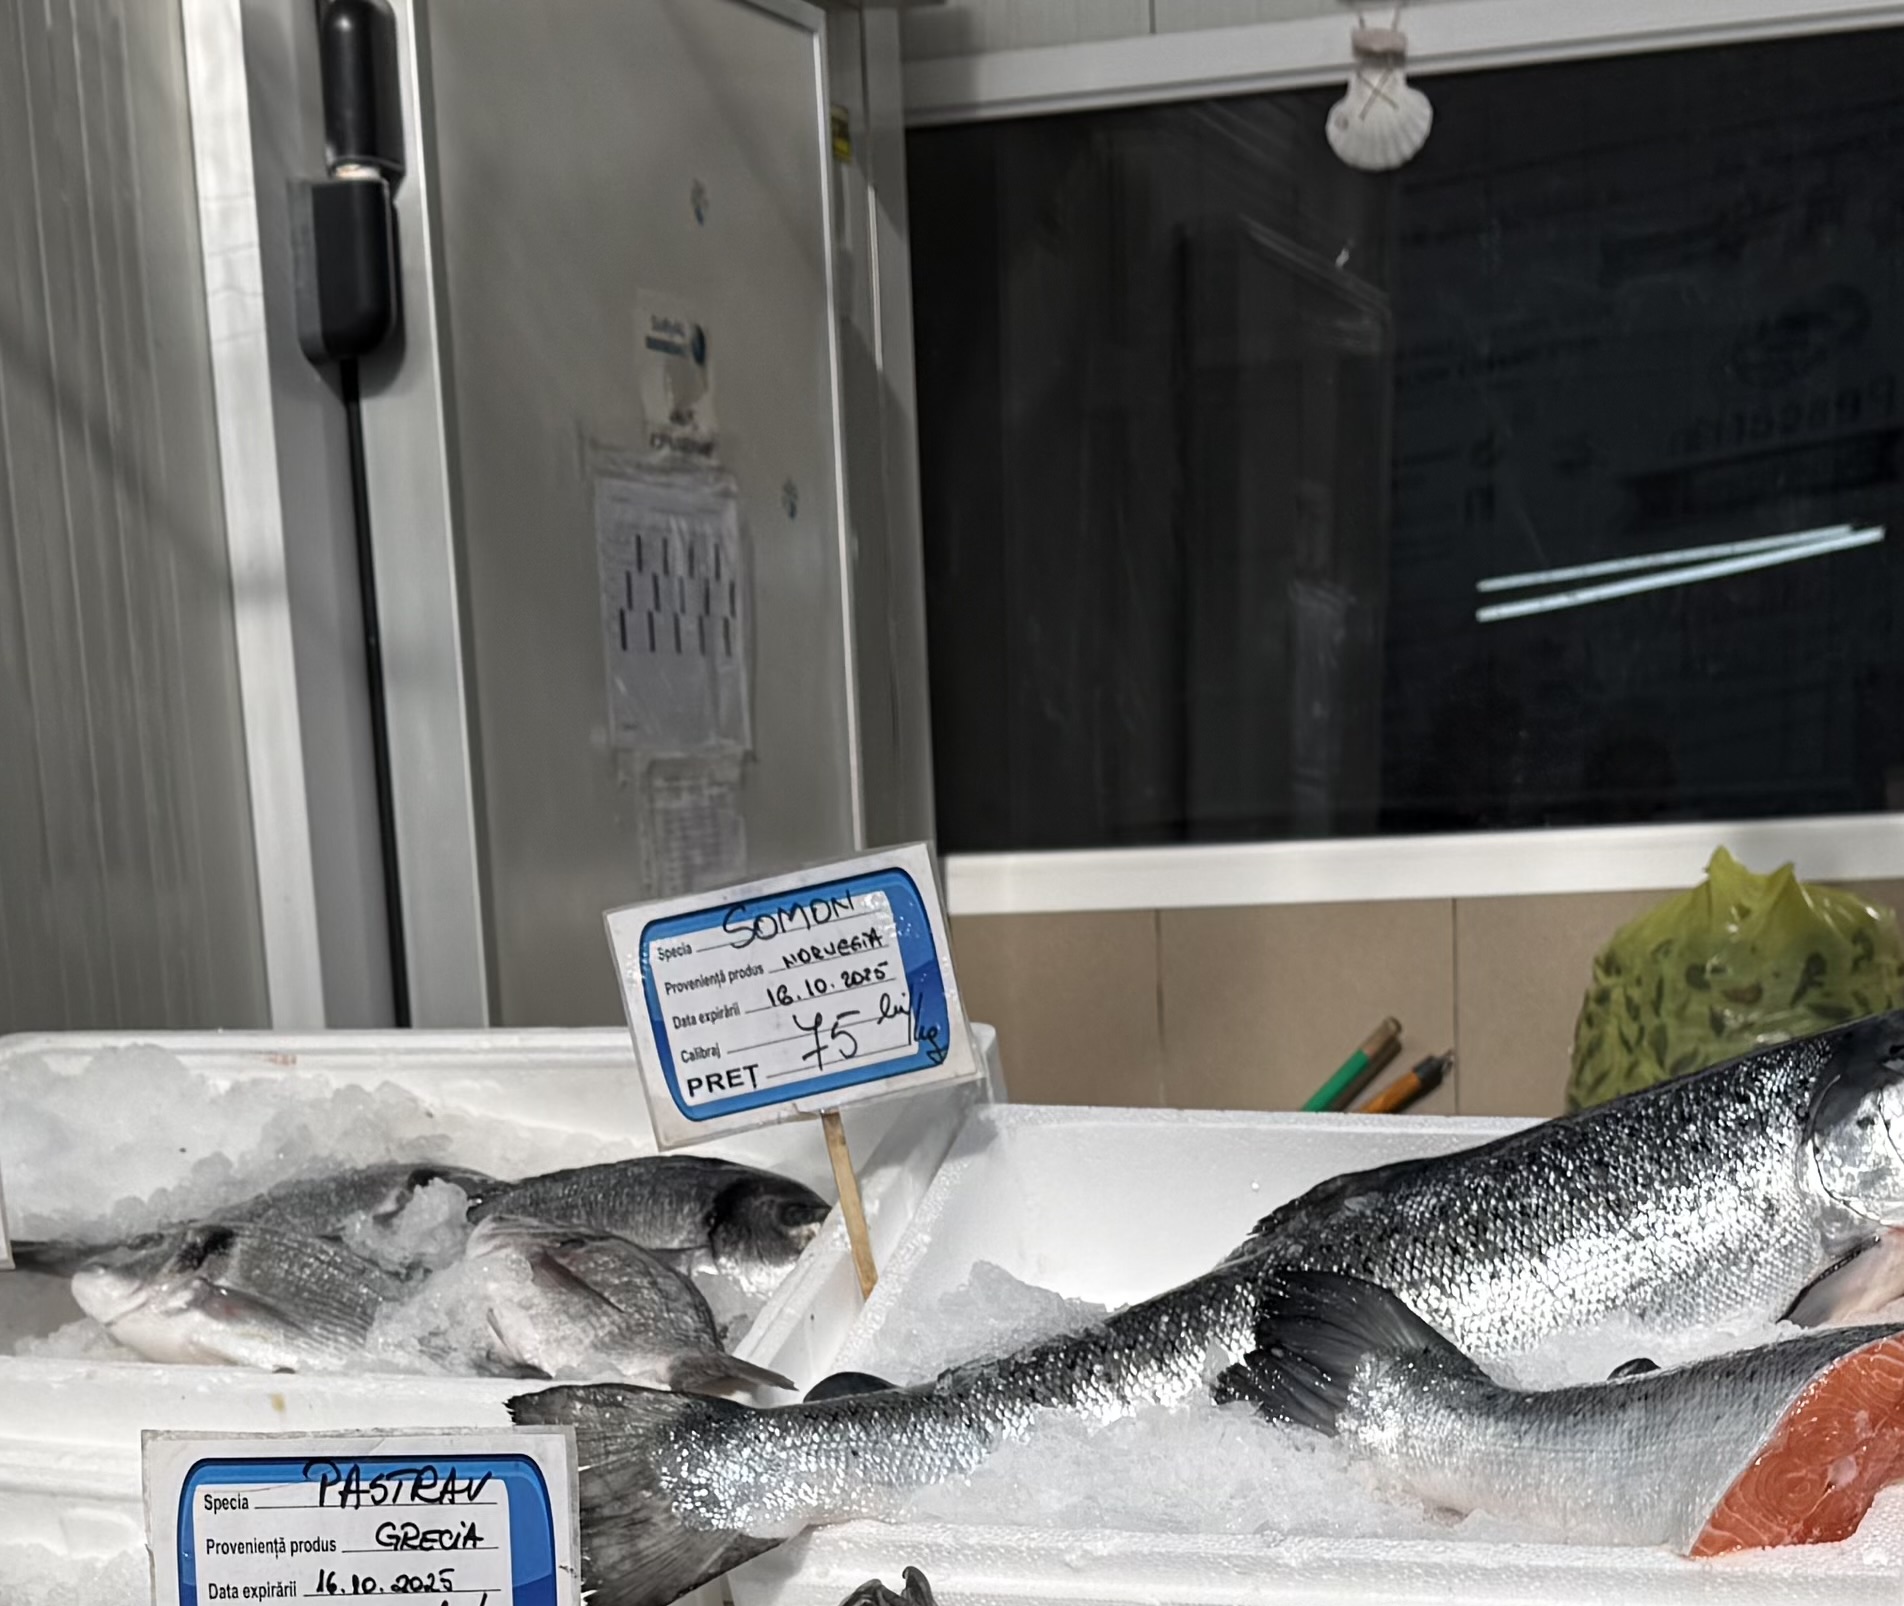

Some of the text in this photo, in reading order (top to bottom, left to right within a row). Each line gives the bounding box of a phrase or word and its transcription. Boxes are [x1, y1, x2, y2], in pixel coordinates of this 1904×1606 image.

[657, 888, 856, 961] Specia SOMON
[664, 970, 727, 996] Proveniență
[728, 963, 765, 987] produs
[672, 1013, 697, 1030] Data
[680, 1042, 722, 1065] Calibraj
[686, 1064, 760, 1097] PREȚ
[792, 1009, 861, 1071] 75
[204, 1458, 494, 1512] Specia PASTRAV
[206, 1521, 485, 1558] Proveniență produs GRECIA
[208, 1583, 240, 1600] Data
[243, 1581, 297, 1600] expirării
